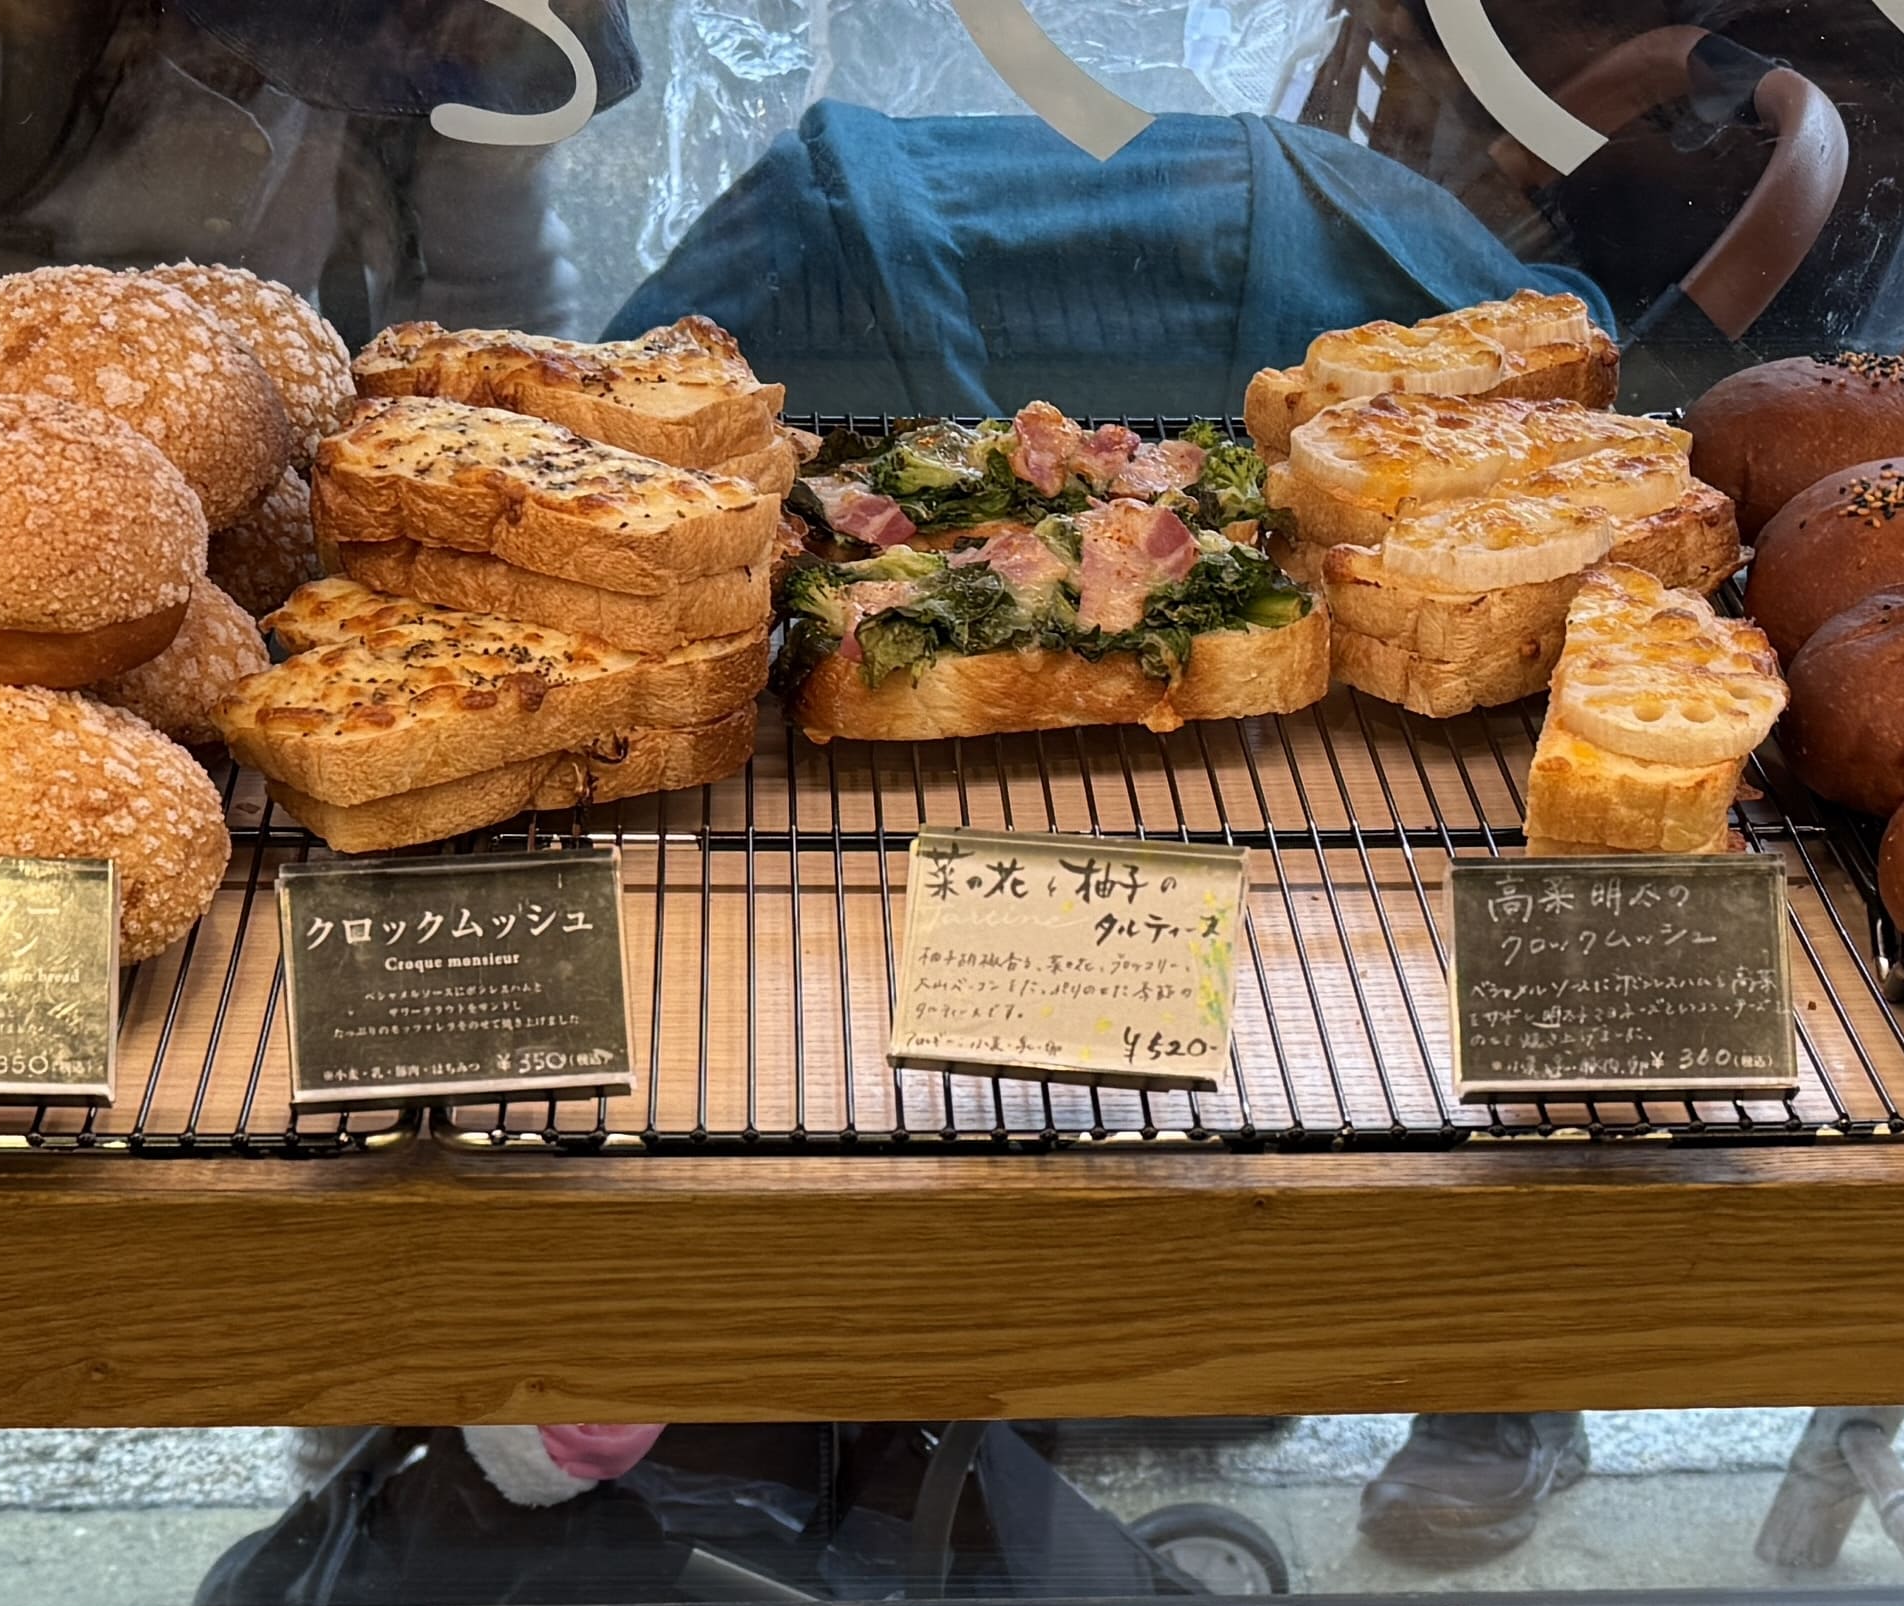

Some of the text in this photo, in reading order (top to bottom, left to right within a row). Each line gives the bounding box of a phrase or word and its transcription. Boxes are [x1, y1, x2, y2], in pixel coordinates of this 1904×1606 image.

[305, 902, 594, 951] クロックムッシュ
[384, 952, 521, 974] Croque monsieur
